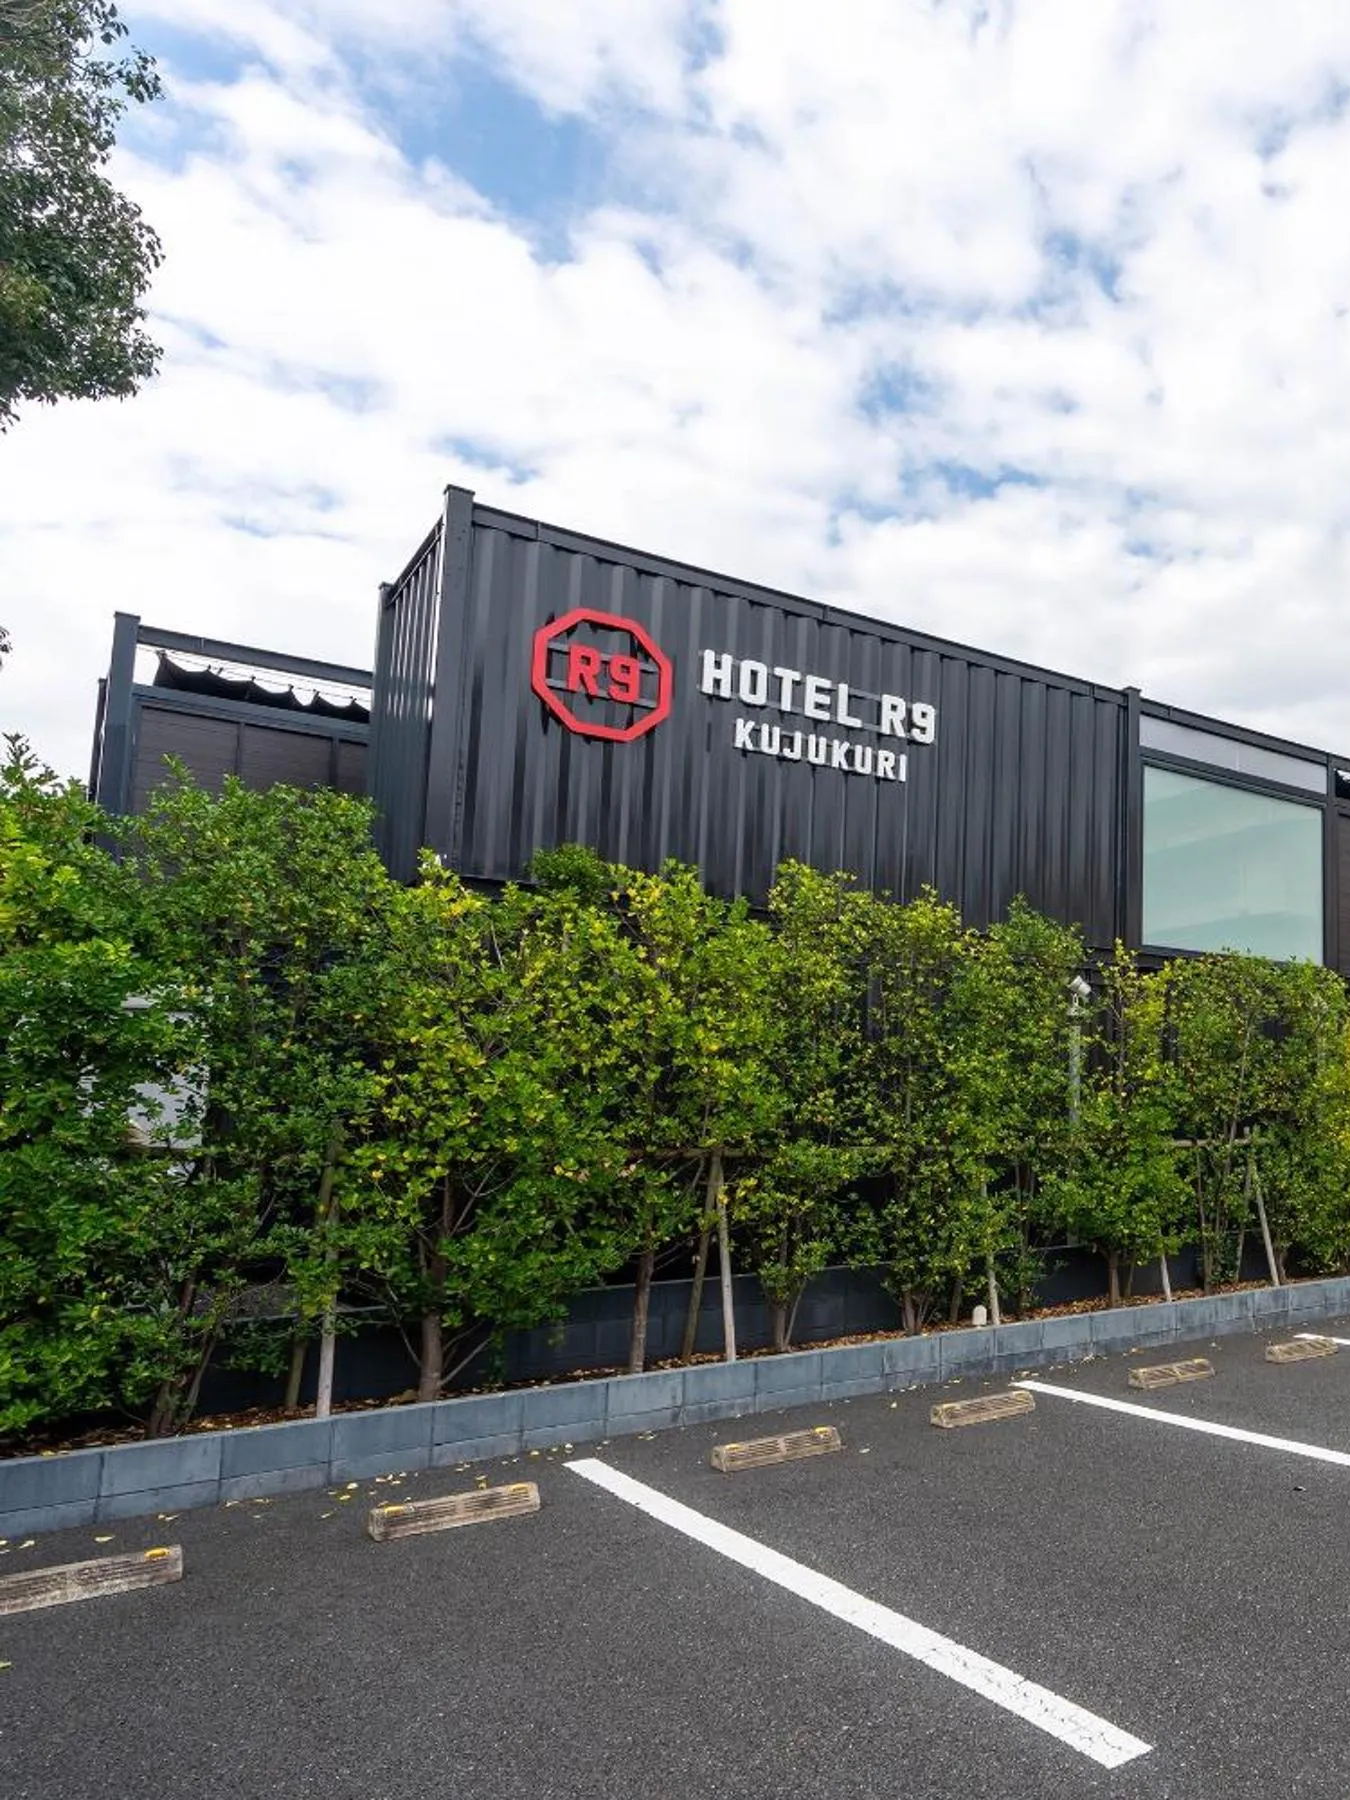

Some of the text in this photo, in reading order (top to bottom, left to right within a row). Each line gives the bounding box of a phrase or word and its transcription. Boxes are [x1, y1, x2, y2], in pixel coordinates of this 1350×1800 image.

[567, 644, 642, 704] R9
[700, 648, 937, 745] HOTEL R9
[732, 717, 907, 783] KUJUKURI
